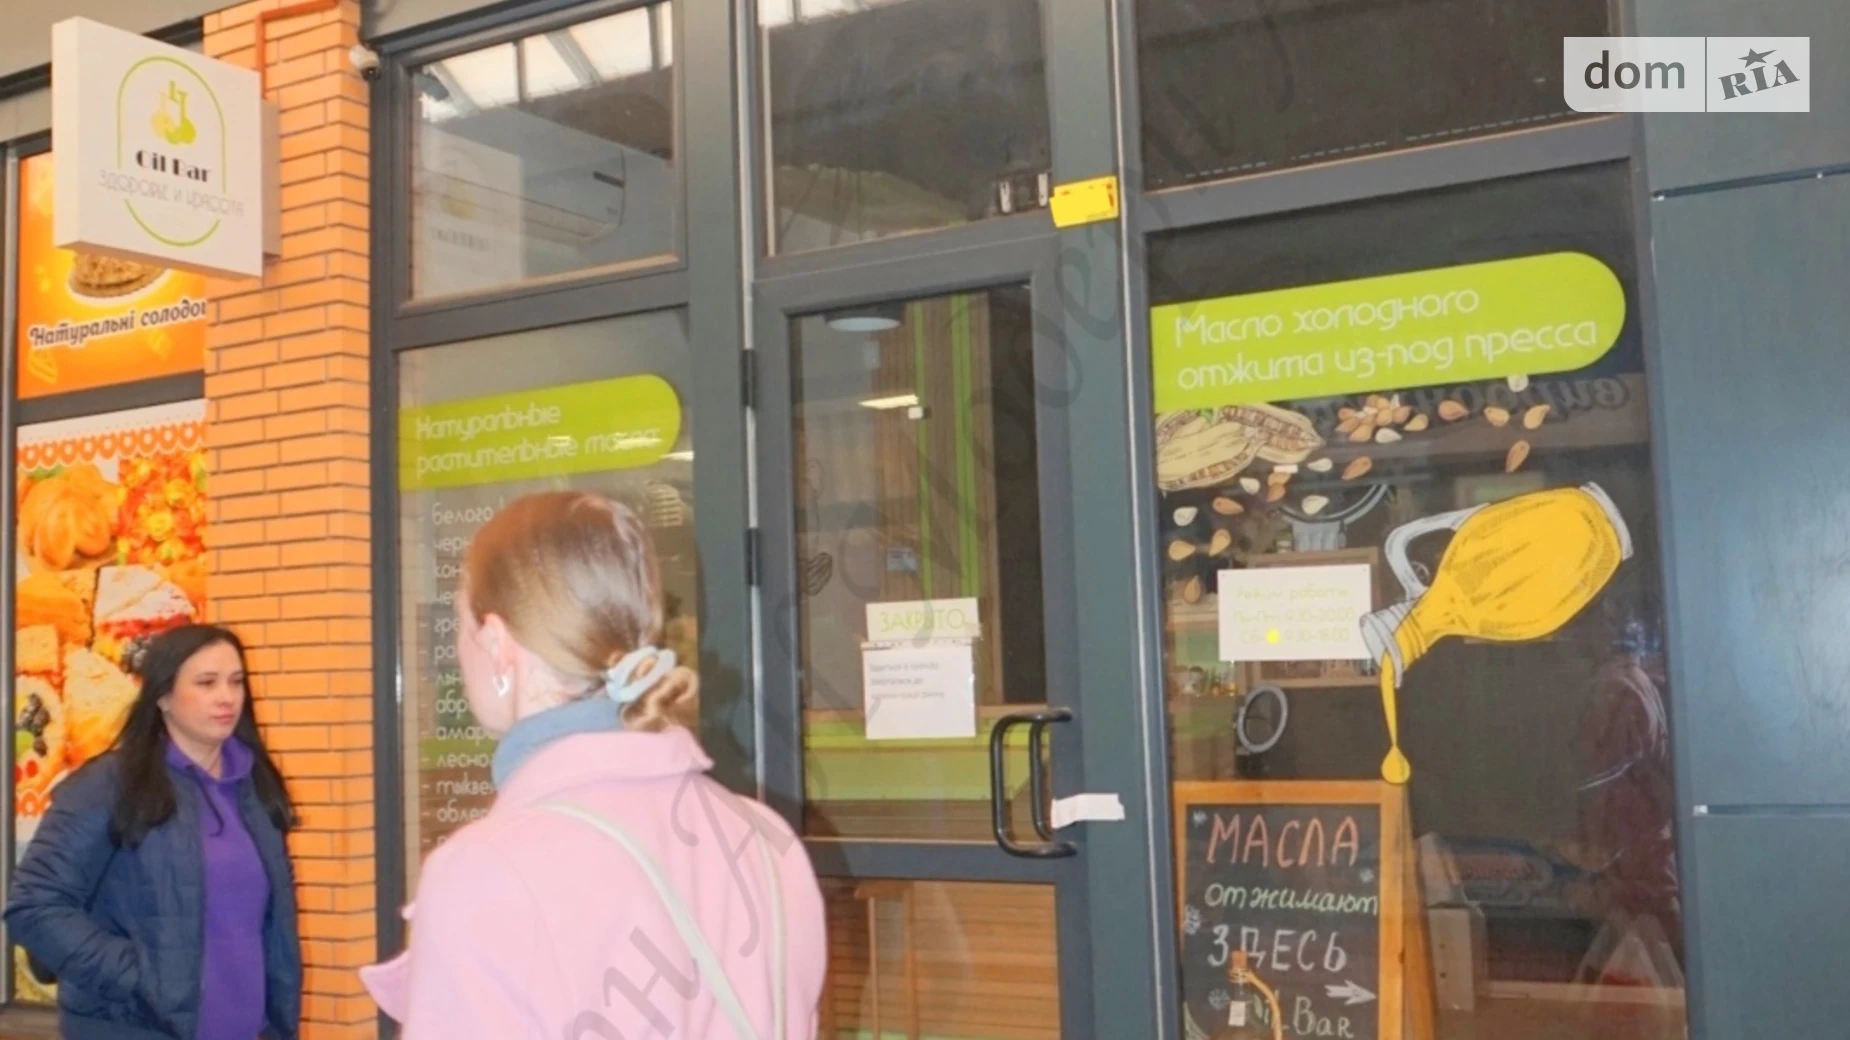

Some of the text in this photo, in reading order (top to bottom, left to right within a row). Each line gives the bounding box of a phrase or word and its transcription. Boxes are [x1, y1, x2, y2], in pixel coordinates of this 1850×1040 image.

[135, 149, 212, 183] Oil Bar
[29, 311, 135, 347] Натуральні
[1176, 289, 1480, 348] Масло холодного
[1334, 337, 1453, 379] из-под
[1465, 320, 1598, 362] пресса
[416, 402, 561, 442] Натуральные
[432, 502, 494, 526] белого
[1206, 813, 1359, 868] МАСЛА
[1207, 924, 1347, 972] ЗДЕСЬ
